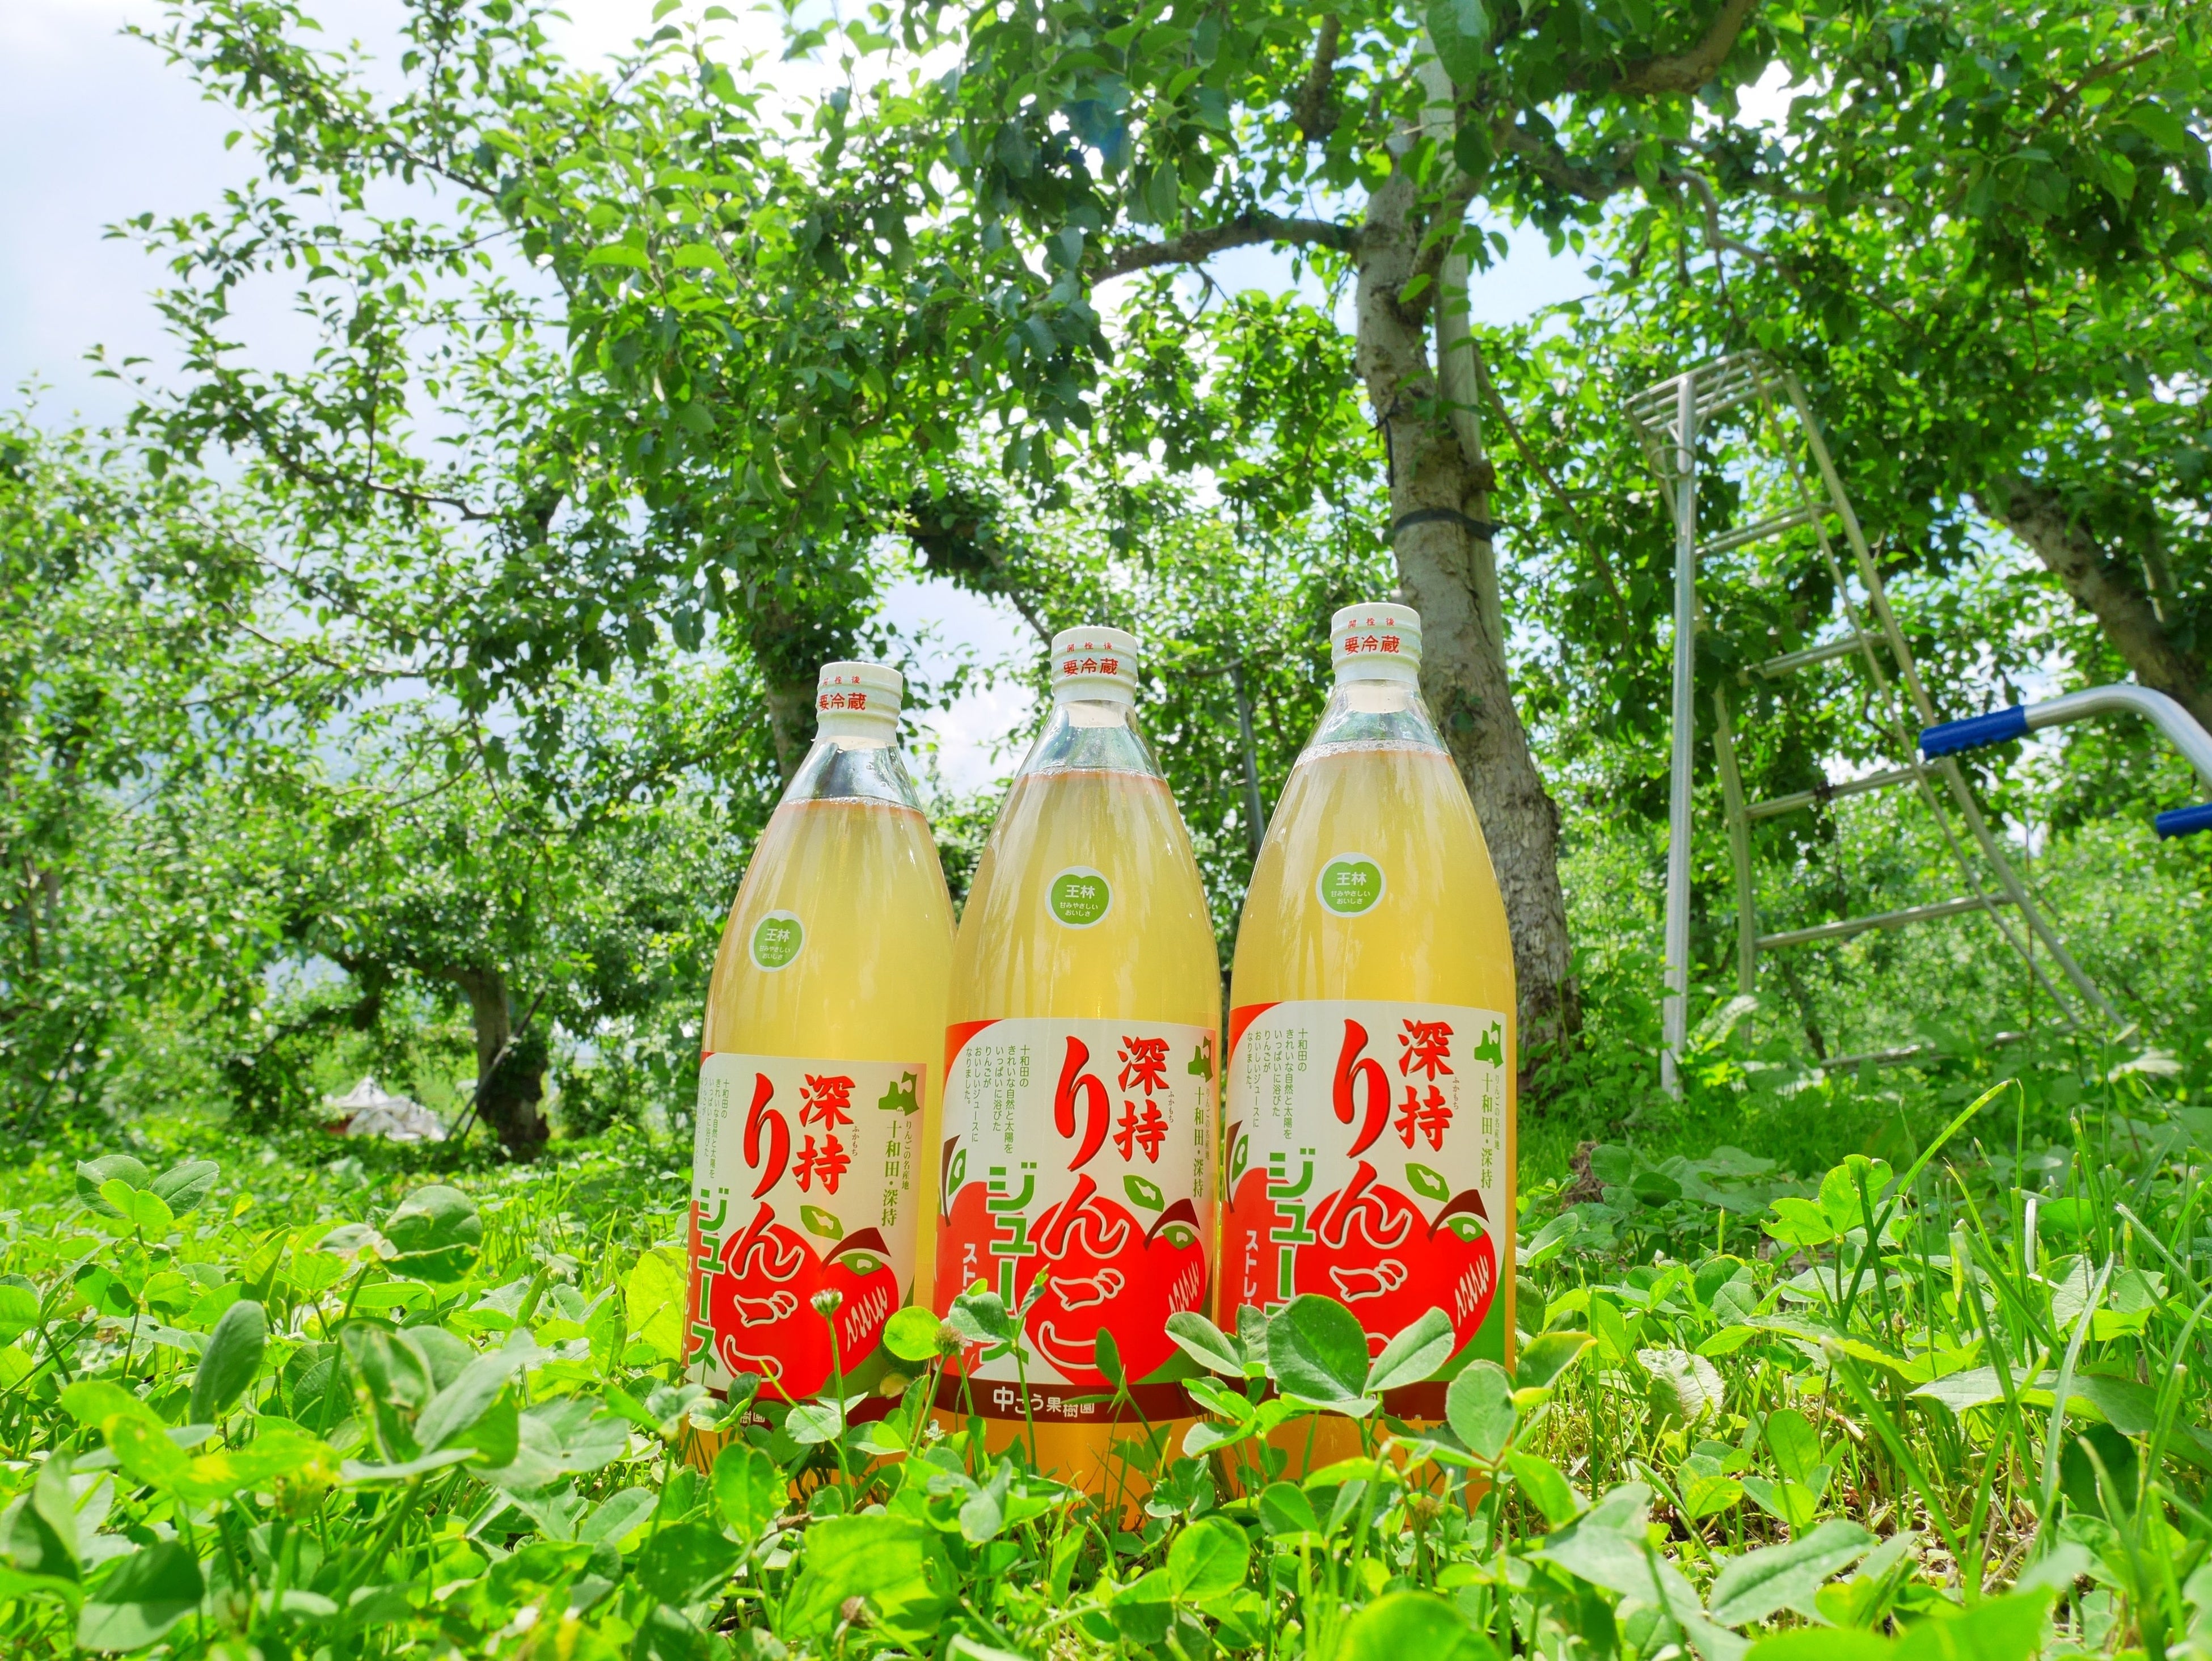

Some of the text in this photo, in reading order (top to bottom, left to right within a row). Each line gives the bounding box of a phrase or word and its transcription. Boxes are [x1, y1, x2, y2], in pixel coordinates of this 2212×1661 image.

[1063, 657, 1118, 677] 要冷蔵
[1345, 635, 1400, 655] 要冷蔵
[819, 693, 867, 711] 要冷蔵
[1065, 885, 1095, 899] 王林
[1336, 872, 1366, 886] 王林
[765, 928, 791, 943] 王林
[972, 1047, 981, 1143] おいしいジュースに
[993, 1047, 1003, 1132] いっぱいに浴びた
[1020, 1045, 1030, 1087] 十和田の
[1253, 1031, 1261, 1128] おいしいジュースに
[1273, 1030, 1282, 1117] いっぱいに浴びた
[1284, 1029, 1294, 1139] きれいな自然と太陽を
[1298, 1028, 1308, 1072] 十和田の
[1394, 1019, 1454, 1152] 深持
[721, 1079, 730, 1119] 十和田の
[792, 1074, 855, 1195] 深持
[1004, 1045, 1016, 1154] きれいな自然と太陽を
[1113, 1035, 1170, 1163] 深持
[1193, 1087, 1204, 1198] 十和田・深持
[1481, 1073, 1493, 1189] 十和田・深持
[881, 1120, 902, 1227] 十和田・深持
[1039, 1035, 1129, 1368] りんご
[724, 1073, 805, 1381] りんご
[1265, 1148, 1316, 1317] ジュー
[688, 1187, 729, 1373] ジュース
